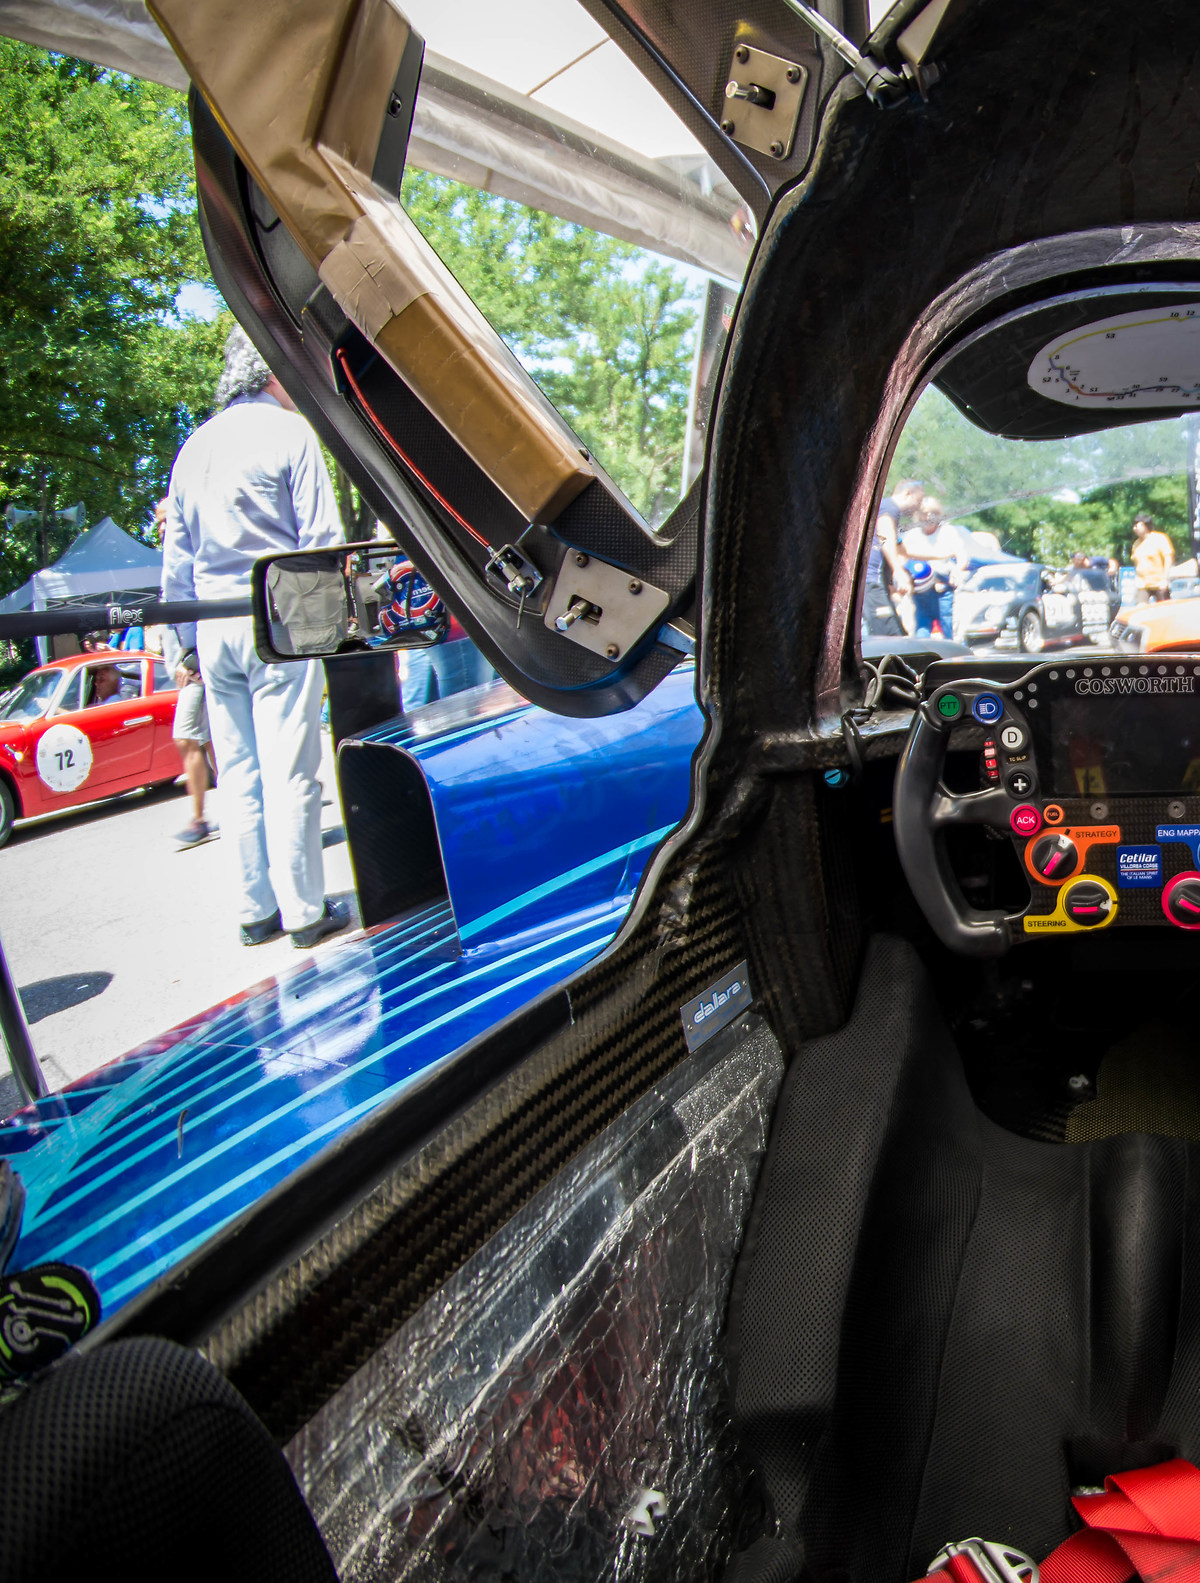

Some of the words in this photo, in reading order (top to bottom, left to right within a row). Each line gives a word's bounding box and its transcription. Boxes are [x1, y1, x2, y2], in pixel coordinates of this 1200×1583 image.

[1075, 677, 1194, 695] COSWORTH
[940, 702, 957, 710] PTT
[54, 749, 75, 771] 72
[1016, 816, 1036, 825] ACK
[1157, 829, 1175, 837] ENG
[1120, 853, 1158, 864] Cetilar
[694, 982, 741, 1023] dallara
